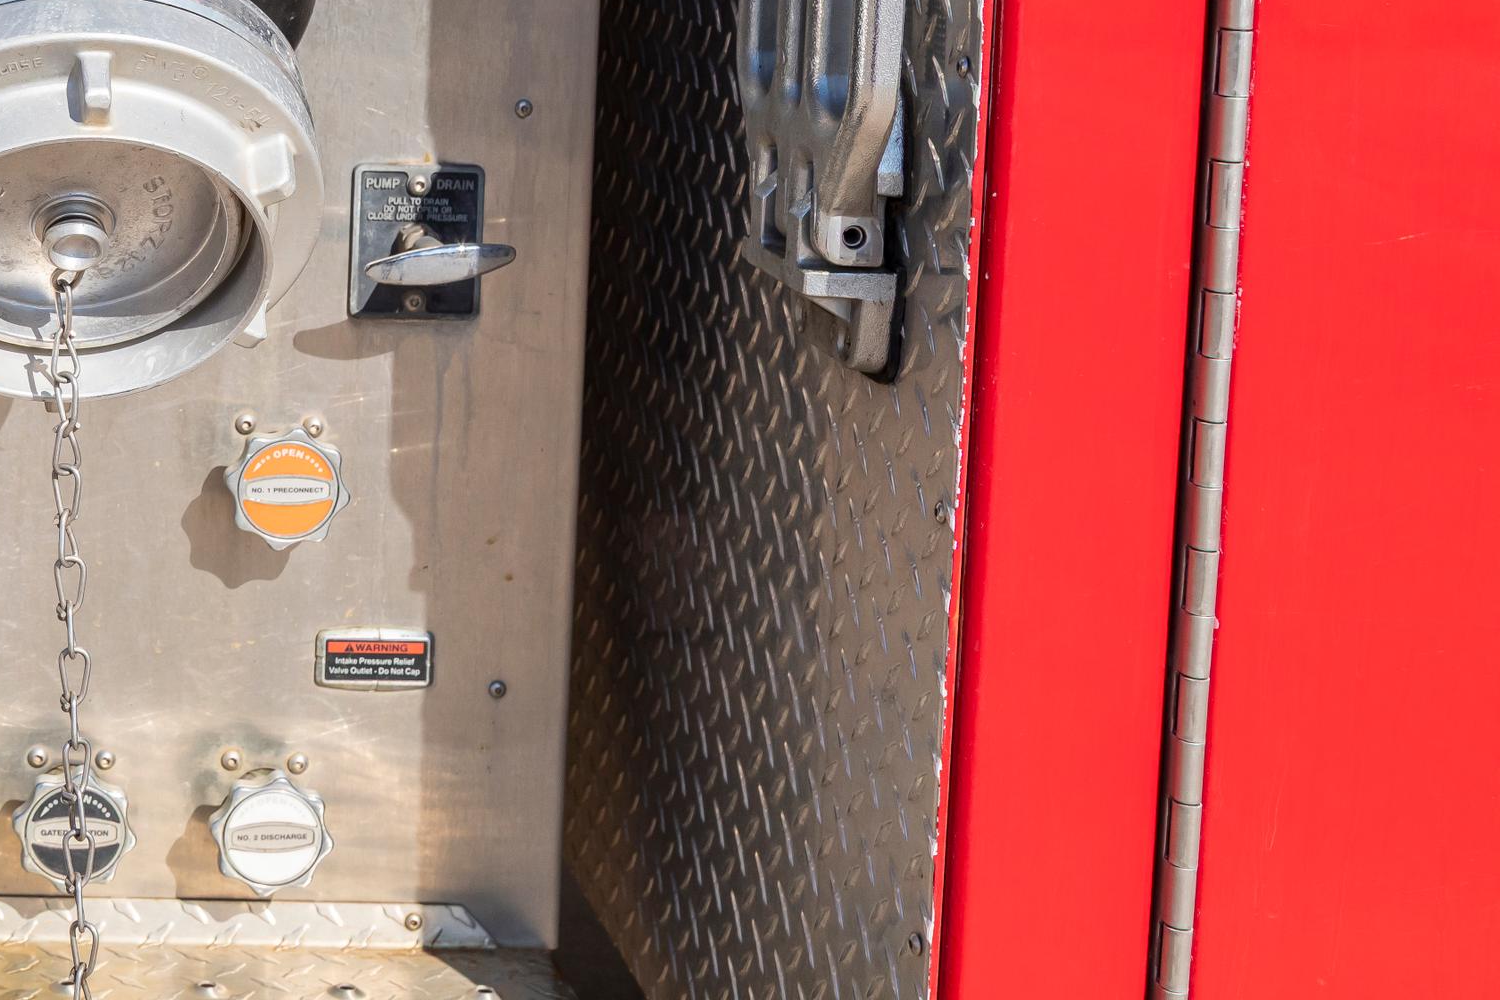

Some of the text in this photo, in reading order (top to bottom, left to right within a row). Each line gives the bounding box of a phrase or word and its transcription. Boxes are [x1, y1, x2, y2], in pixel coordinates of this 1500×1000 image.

[365, 177, 475, 191] PUMP DRAIN
[388, 197, 449, 206] PULL TO DRAIN
[140, 175, 174, 249] STORZ
[397, 205, 415, 214] NOT
[441, 206, 452, 214] OR
[367, 212, 393, 221] CLOSE
[426, 214, 468, 222] PRESSURE
[273, 448, 305, 459] OPEN
[355, 644, 408, 652] WARNING
[335, 657, 415, 666] Intake Pressure Relief
[329, 667, 349, 675] Valve
[350, 667, 373, 675] Outlet
[378, 667, 389, 675] Do
[390, 667, 404, 676] Not
[405, 667, 420, 677] Cap
[260, 833, 308, 841] DISCHARGE
